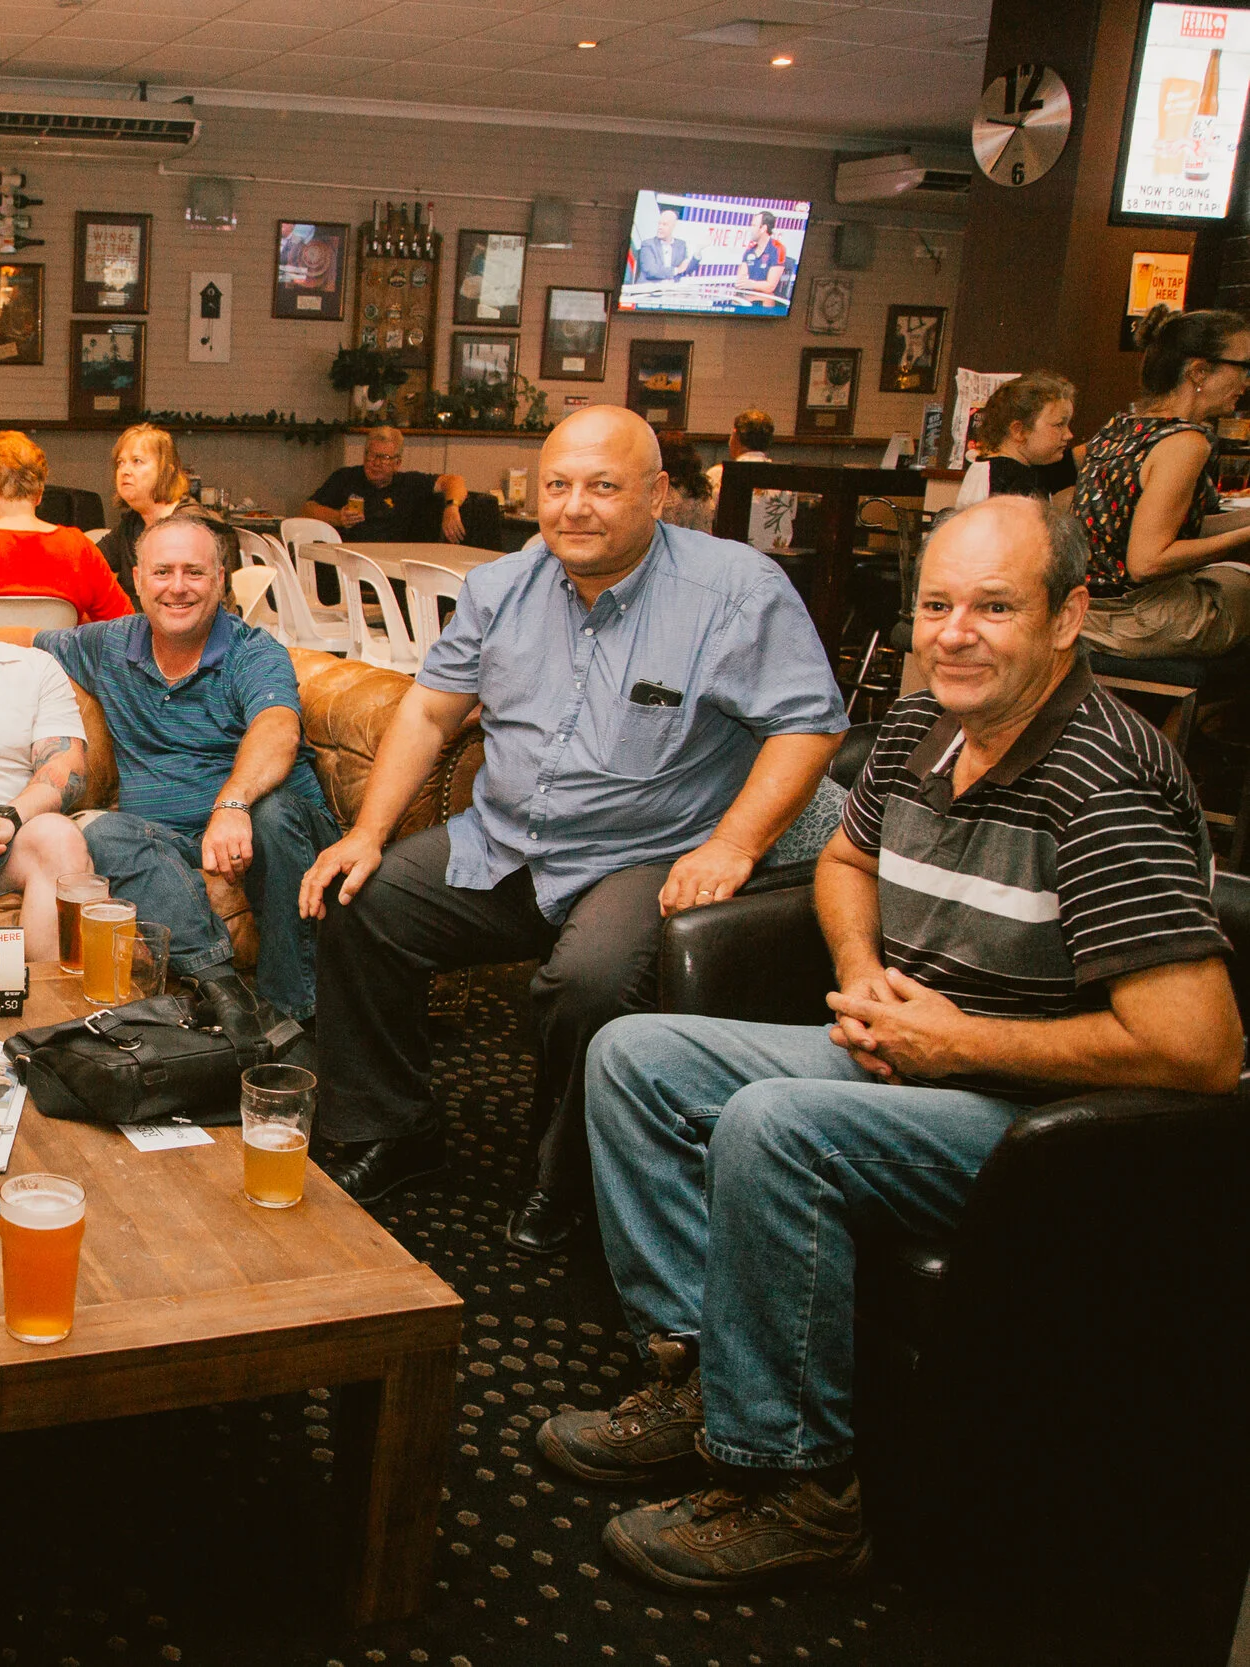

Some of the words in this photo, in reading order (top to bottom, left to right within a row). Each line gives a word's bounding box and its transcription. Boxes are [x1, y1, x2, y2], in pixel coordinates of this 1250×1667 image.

[1182, 11, 1214, 30] FERAL
[1004, 63, 1044, 115] 12
[1011, 161, 1025, 186] 6
[1139, 185, 1162, 197] NOW
[1169, 187, 1210, 199] POURING
[1126, 198, 1139, 209] $8
[1144, 199, 1173, 211] PINTS
[1178, 201, 1191, 211] ON
[1152, 277, 1165, 288] ON
[1167, 277, 1184, 289] TAP
[1155, 289, 1178, 300] HERE
